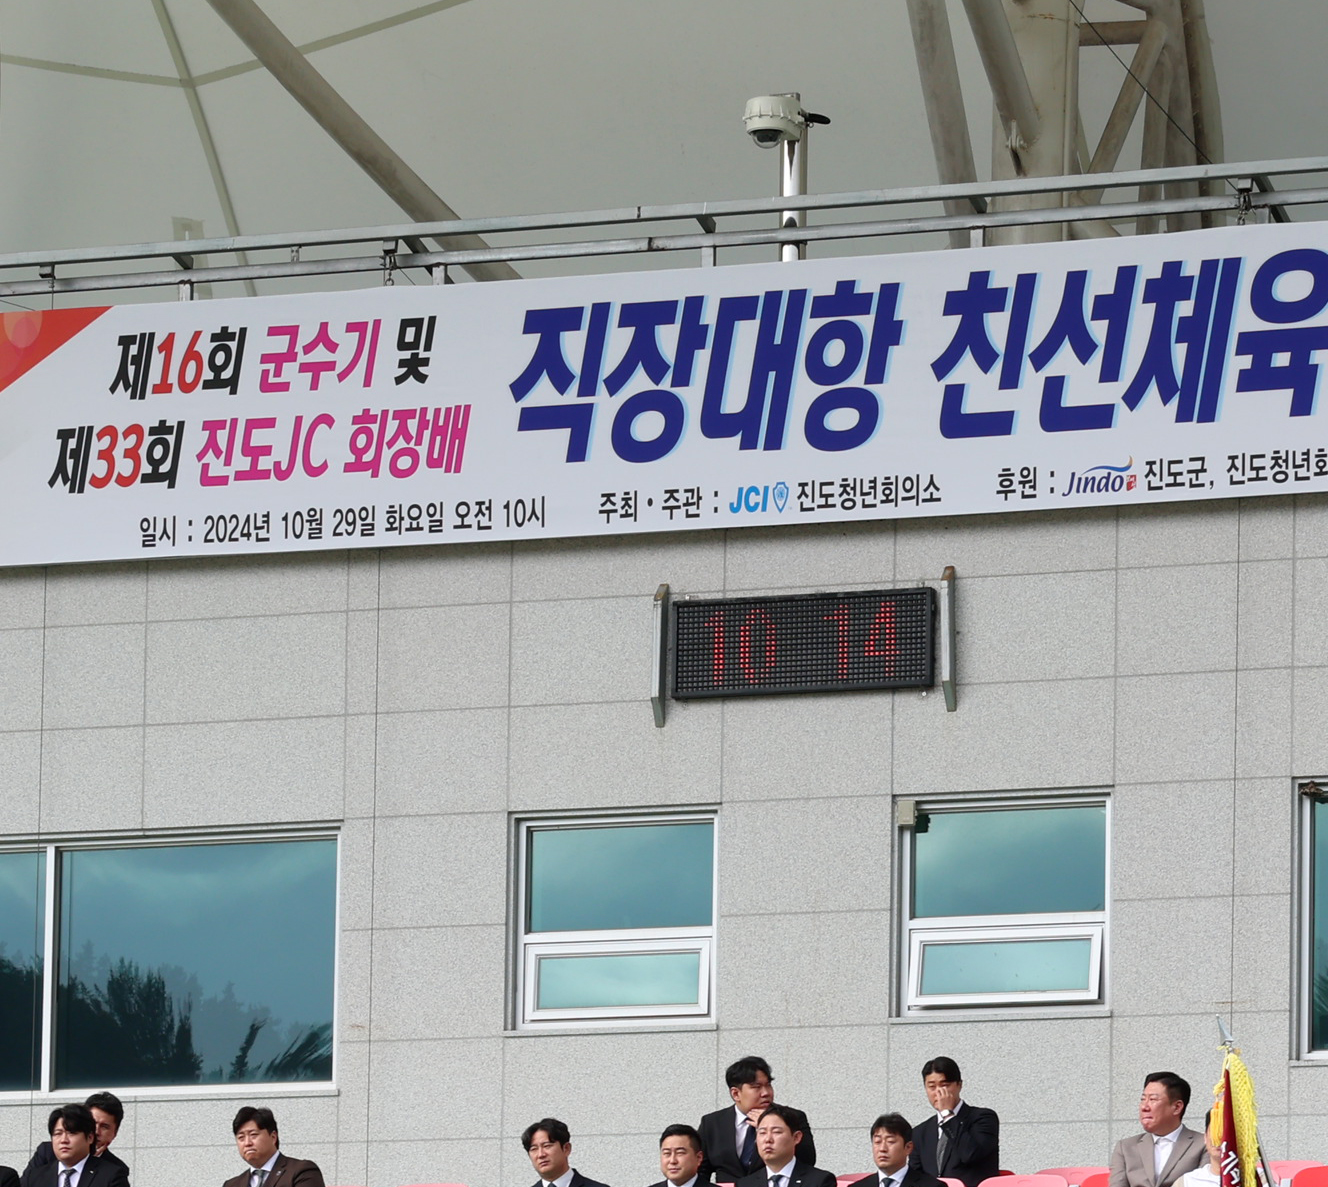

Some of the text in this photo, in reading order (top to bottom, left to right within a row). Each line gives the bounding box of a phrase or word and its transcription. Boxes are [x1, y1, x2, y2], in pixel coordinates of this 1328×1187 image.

[109, 316, 436, 400] 제16회 군수기 및
[508, 279, 905, 464] 직장대항
[47, 403, 472, 495] 제33회 진도JC 회장배
[995, 466, 1038, 501] 후원
[1061, 469, 1125, 497] Jindo
[139, 515, 177, 549] 일시
[203, 509, 271, 545] 2024년
[281, 505, 323, 541] 10월
[332, 502, 377, 539] 29일
[385, 499, 444, 536] 화요일
[452, 496, 493, 532] 오전
[503, 493, 547, 529] 10시
[598, 490, 638, 525] 주최
[661, 486, 702, 519] 주관
[729, 484, 769, 515] JCI
[796, 473, 942, 513] 진도청년회의소
[704, 601, 902, 686] 10 14
